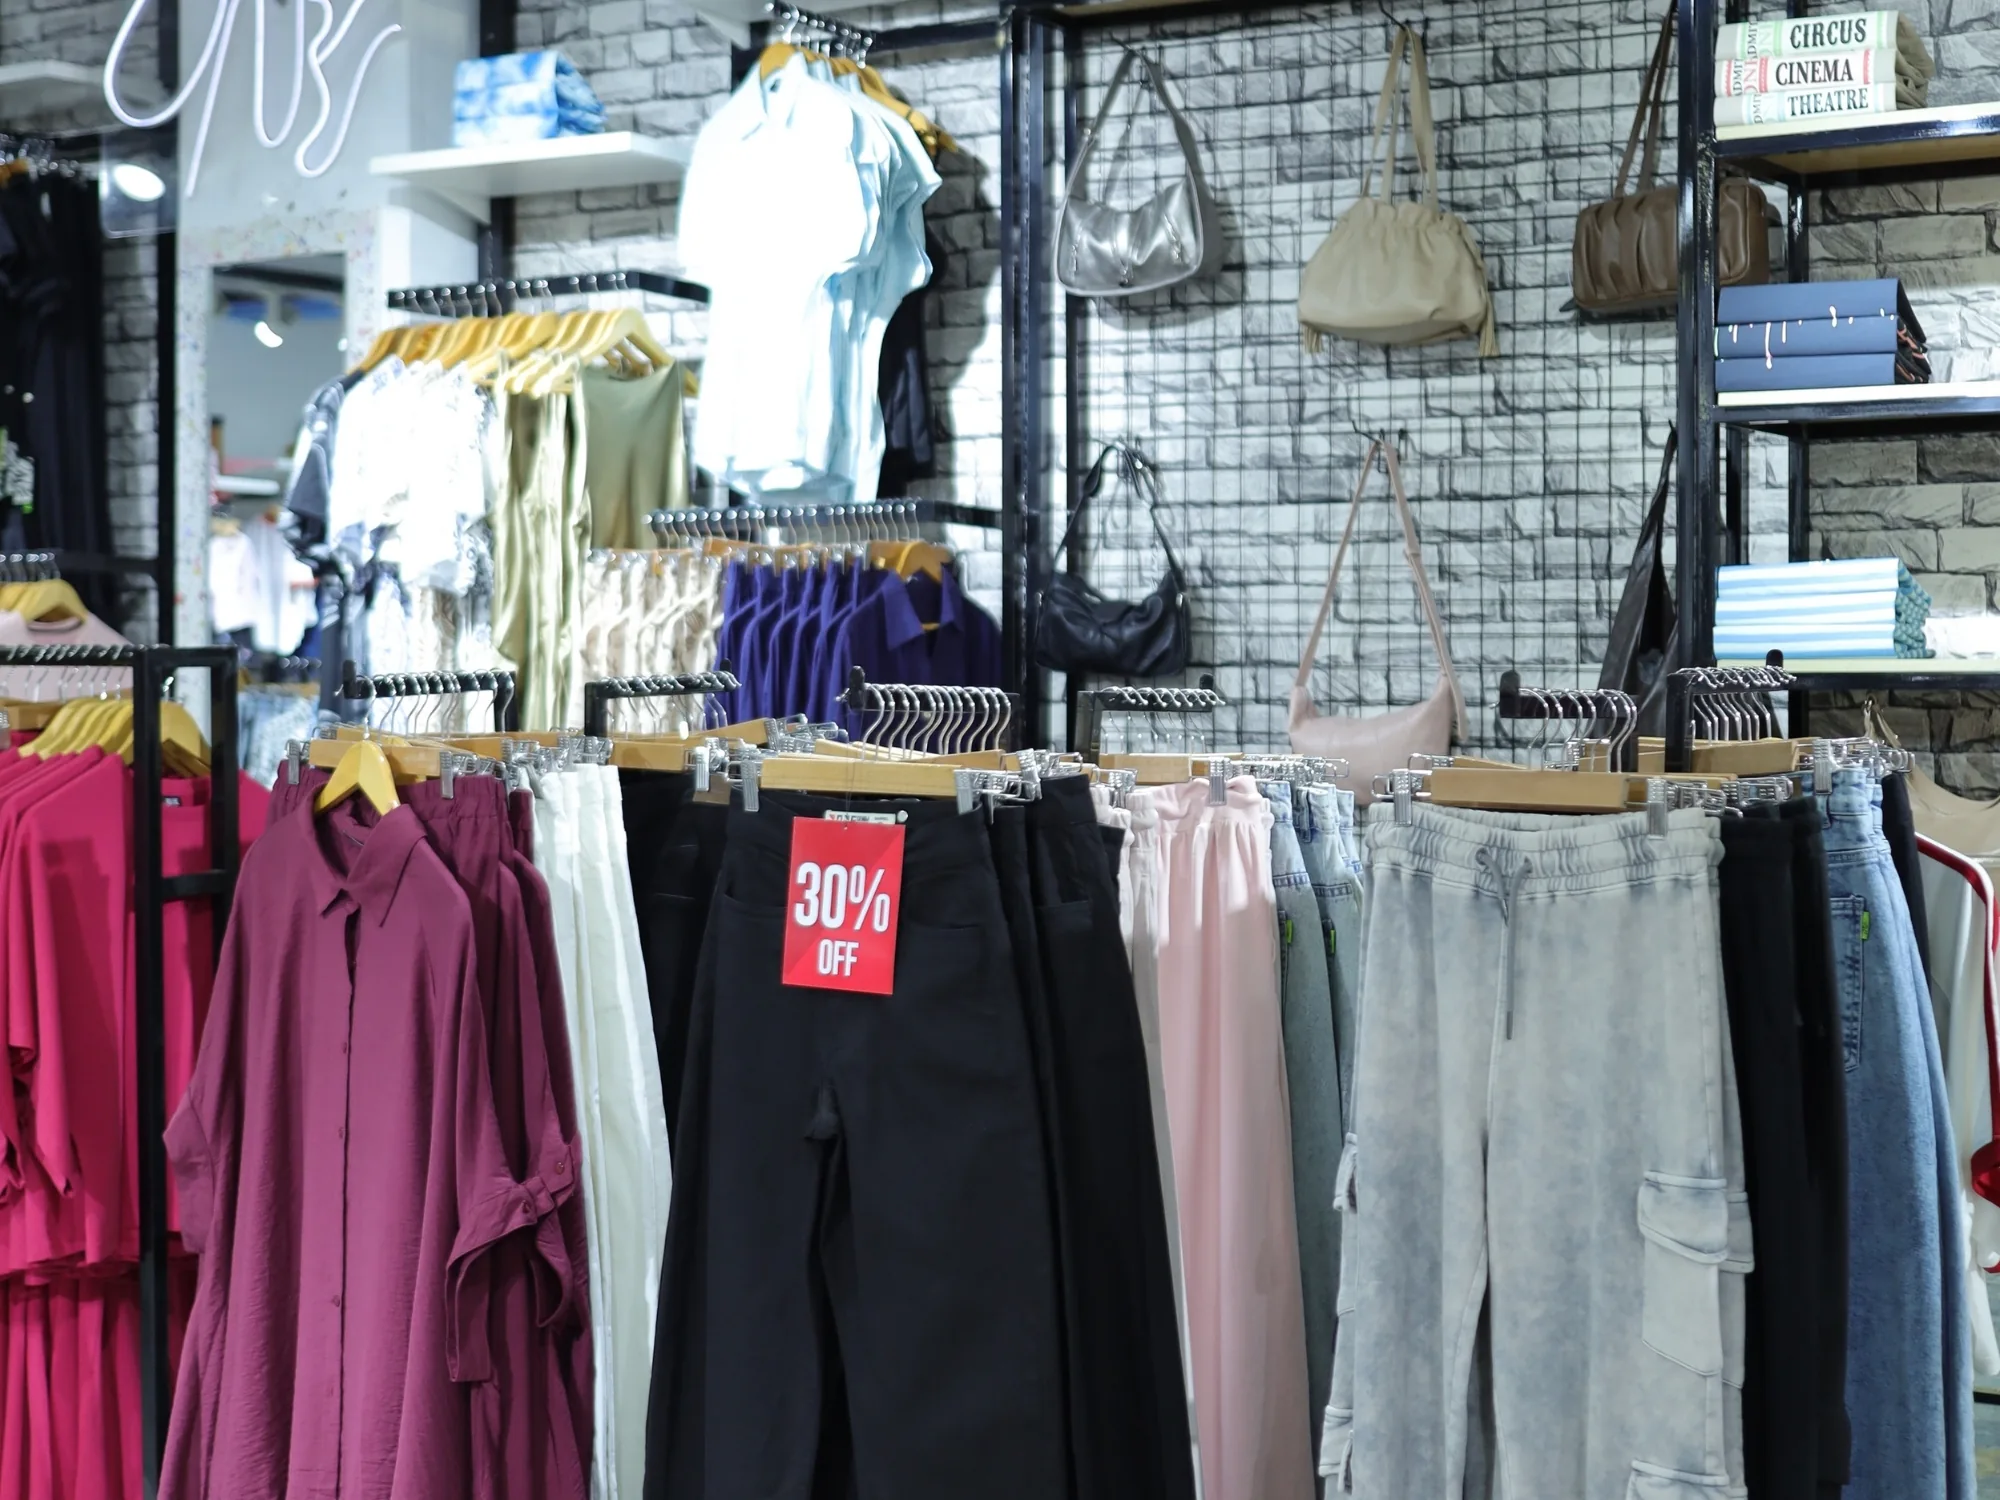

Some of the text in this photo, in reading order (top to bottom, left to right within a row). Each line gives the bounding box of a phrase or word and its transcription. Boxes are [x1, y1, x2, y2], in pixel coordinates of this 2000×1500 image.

[1790, 18, 1867, 49] CIRCUS
[1775, 58, 1854, 86] CINEMA
[1787, 88, 1869, 116] THEATRE
[794, 861, 891, 933] 30%
[817, 938, 860, 977] OFF
